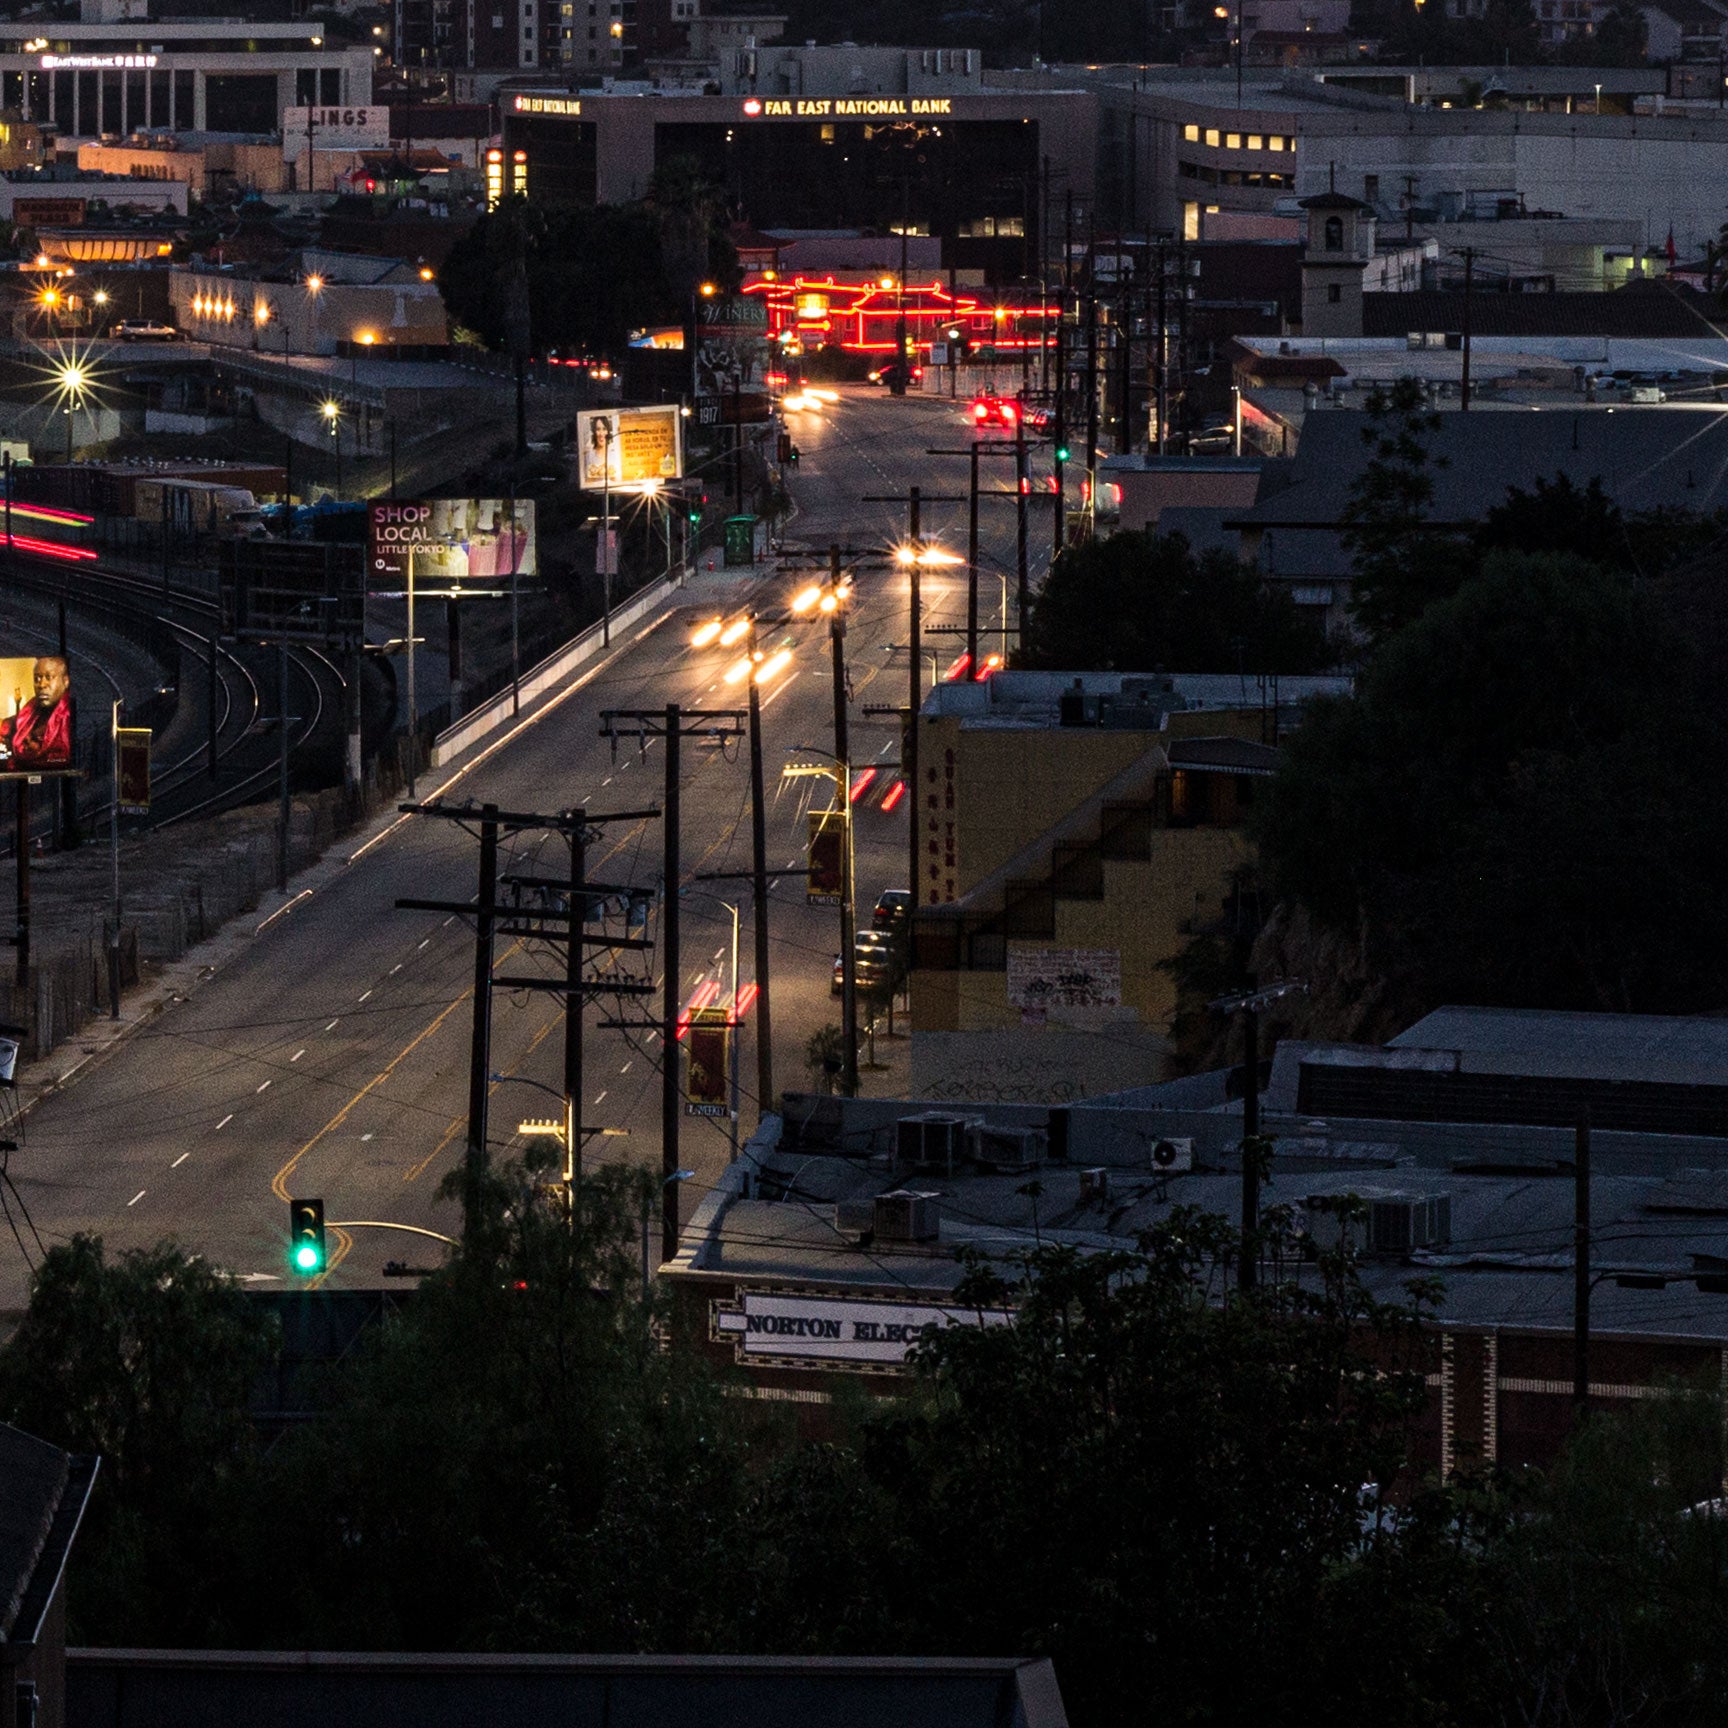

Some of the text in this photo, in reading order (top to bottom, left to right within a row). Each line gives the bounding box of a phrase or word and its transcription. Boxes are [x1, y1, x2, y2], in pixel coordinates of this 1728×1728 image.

[765, 99, 951, 115] FAR EAST NATIONAL BANK
[700, 303, 767, 323] WINERY
[699, 406, 719, 424] 1917
[375, 507, 430, 523] SHOP
[375, 527, 432, 541] LOCAL
[377, 544, 408, 554] LITTLE
[745, 1313, 842, 1340] NORTON
